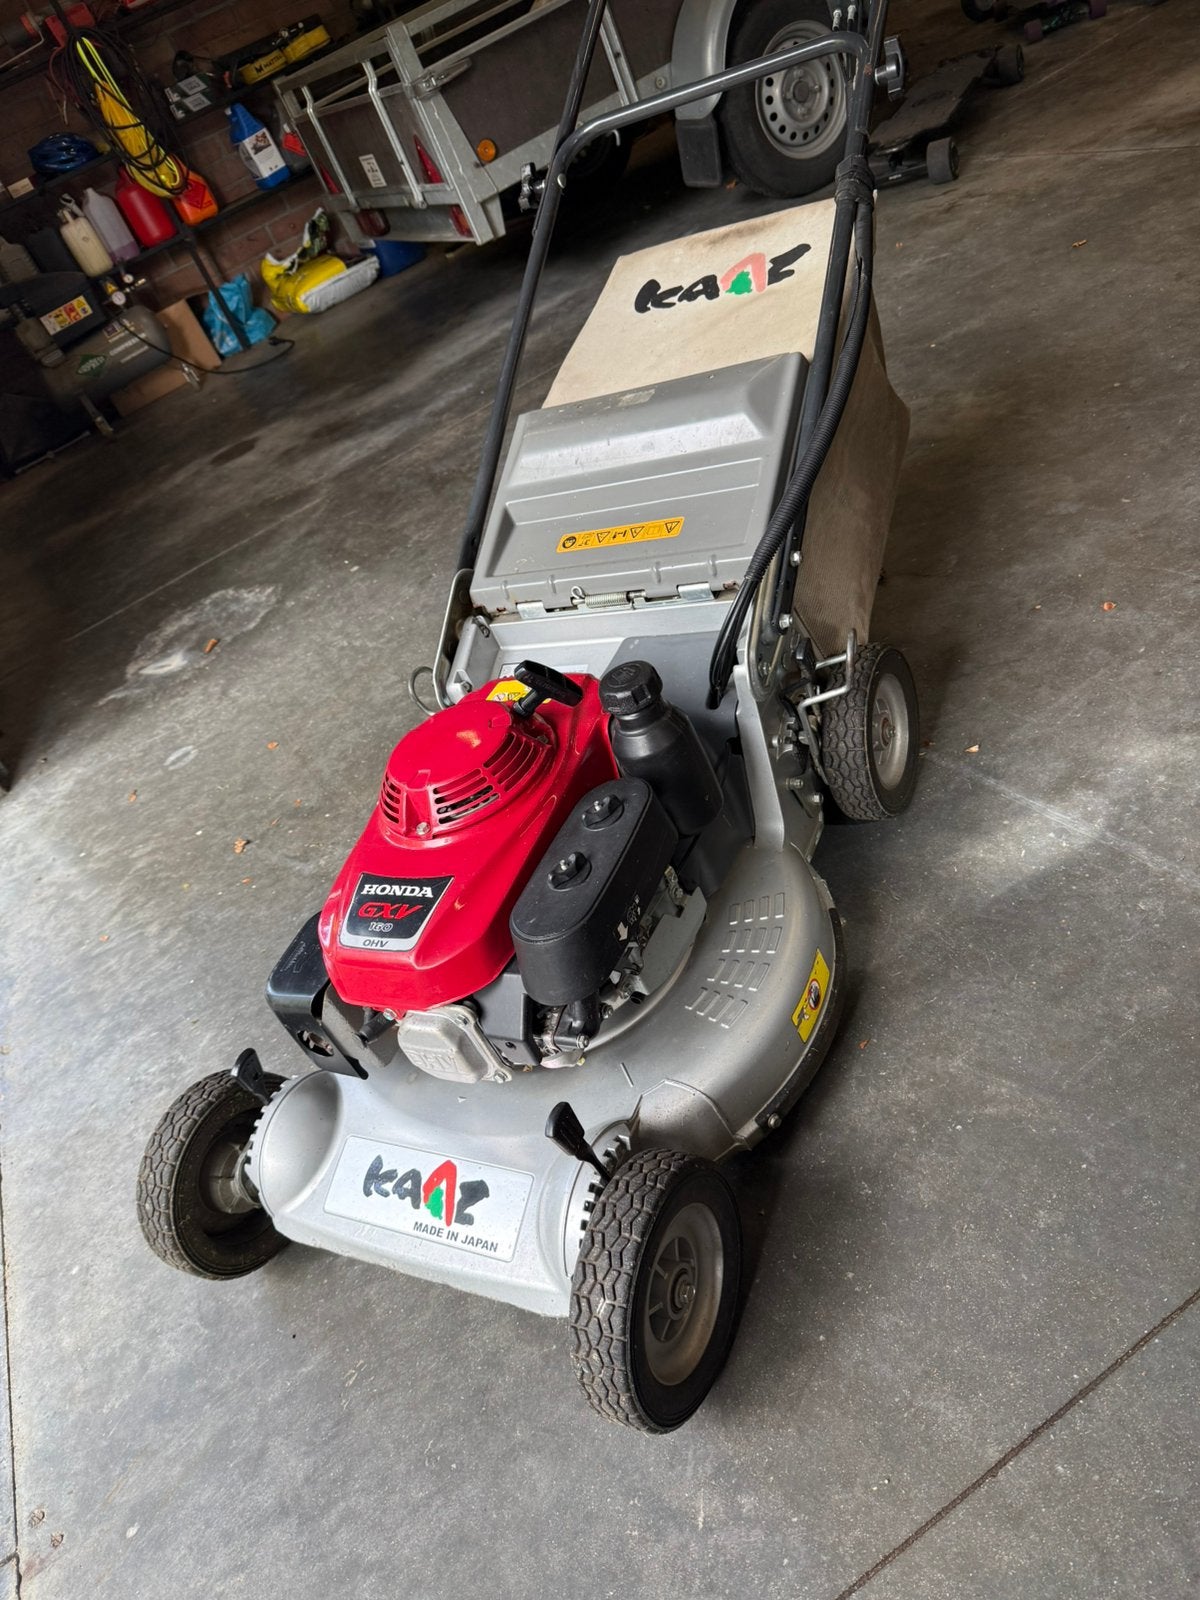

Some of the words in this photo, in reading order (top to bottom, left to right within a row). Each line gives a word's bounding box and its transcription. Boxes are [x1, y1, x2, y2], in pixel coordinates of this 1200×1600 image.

[634, 243, 812, 314] KAAZ
[361, 884, 434, 898] HONDA
[358, 902, 423, 919] GXV
[368, 921, 394, 933] 160
[362, 939, 389, 948] OHV
[363, 1154, 490, 1227] KAAZ
[413, 1221, 445, 1238] MADE
[446, 1230, 459, 1242] IN
[461, 1234, 499, 1253] JAPAN
